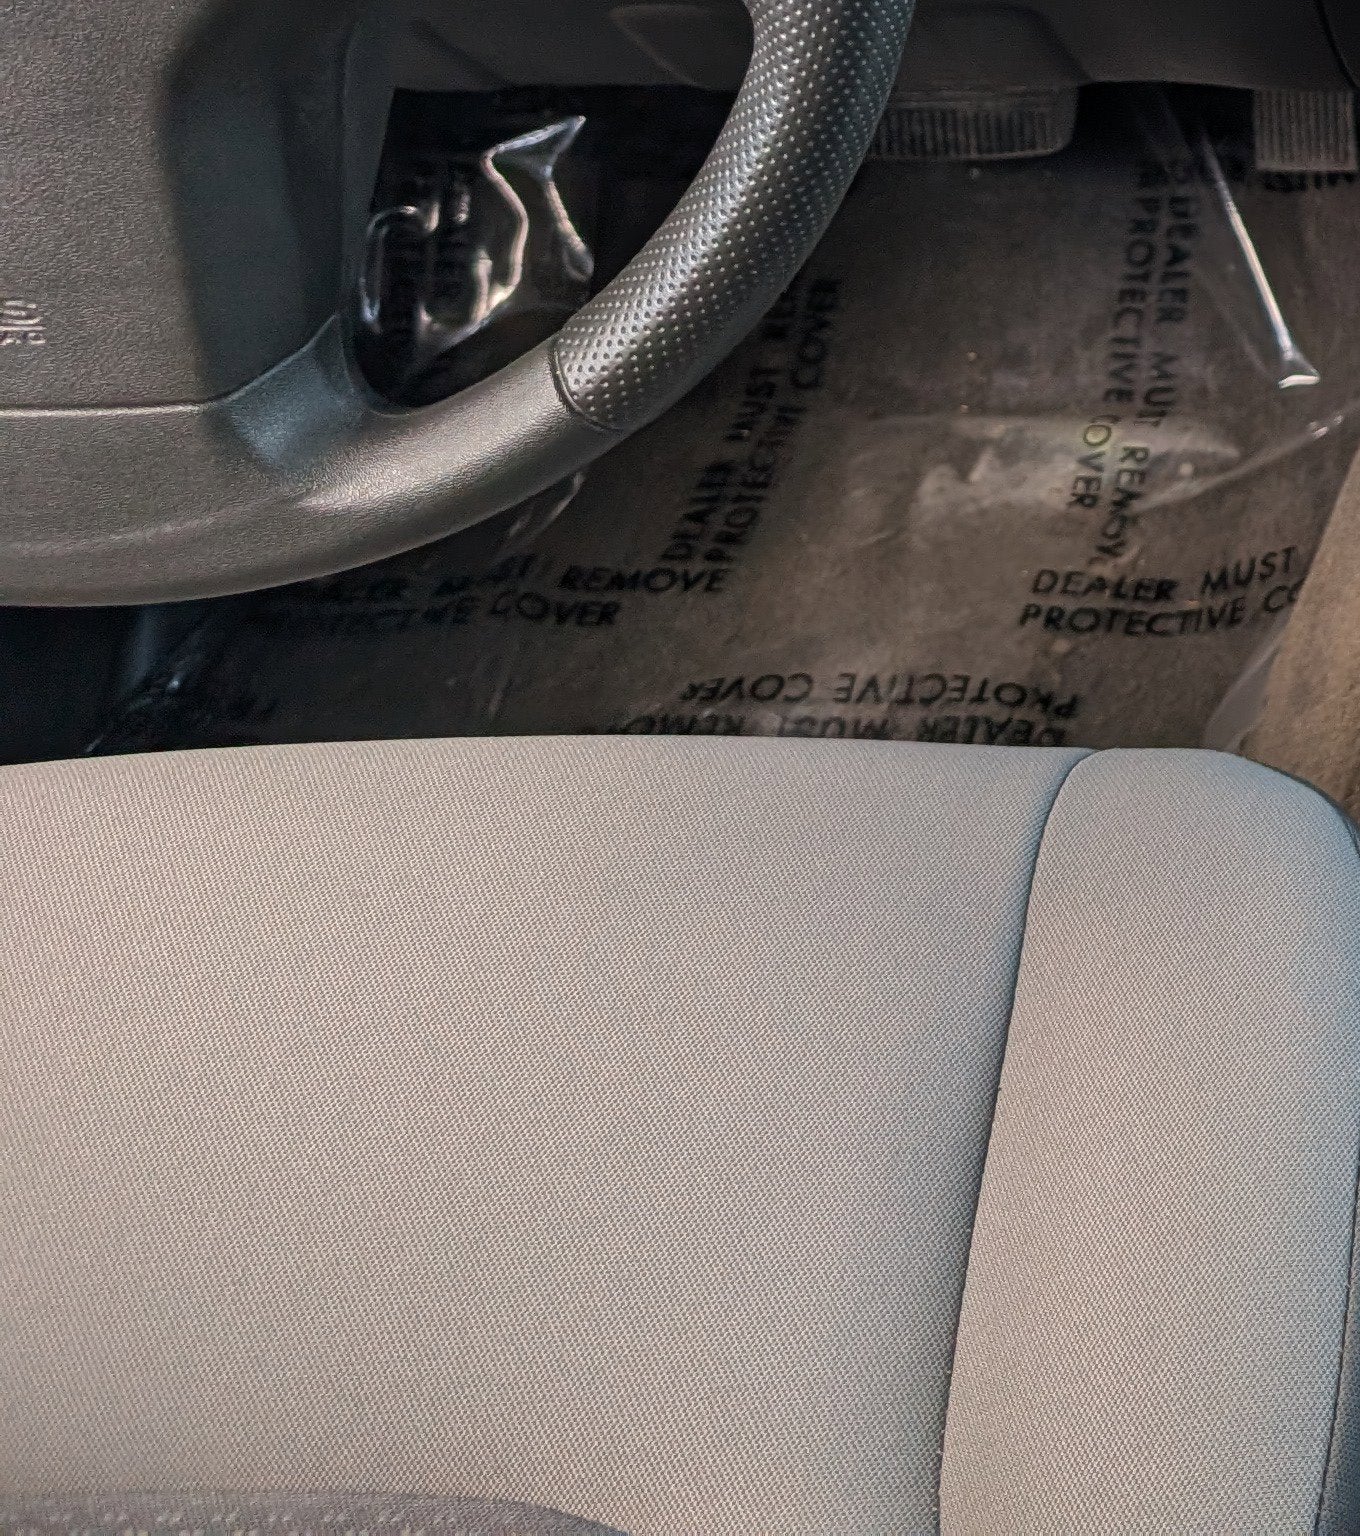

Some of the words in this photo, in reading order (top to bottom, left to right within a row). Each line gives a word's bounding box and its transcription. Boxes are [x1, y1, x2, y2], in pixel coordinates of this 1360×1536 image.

[558, 564, 732, 595] REMOVE
[1030, 568, 1182, 604] DEALER
[1202, 544, 1300, 595] MUST
[1017, 595, 1249, 639] PROTECTIVE
